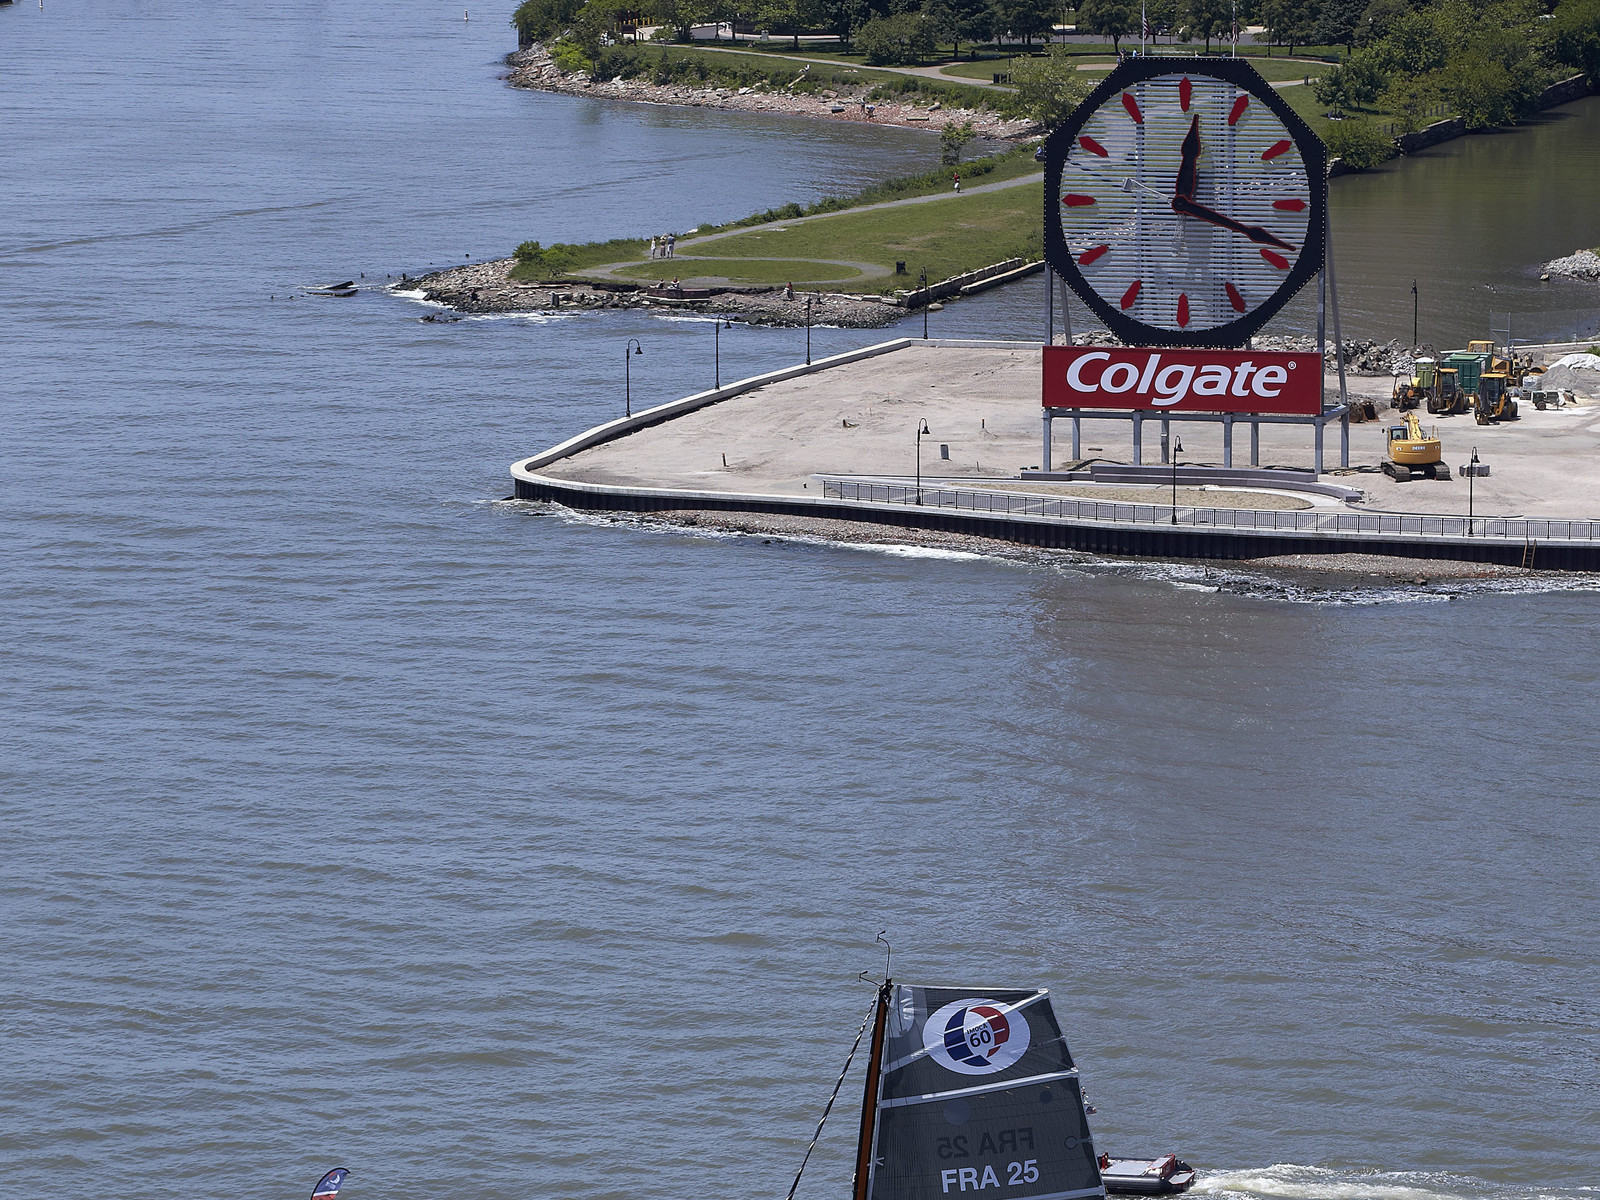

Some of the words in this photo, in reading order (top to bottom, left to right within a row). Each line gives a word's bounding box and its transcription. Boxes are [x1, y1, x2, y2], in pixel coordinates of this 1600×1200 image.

[1066, 352, 1287, 406] Colgate
[966, 1023, 988, 1034] IMOCA
[969, 1029, 991, 1047] 60
[941, 1165, 1001, 1193] FRA
[1007, 1159, 1039, 1186] 25
